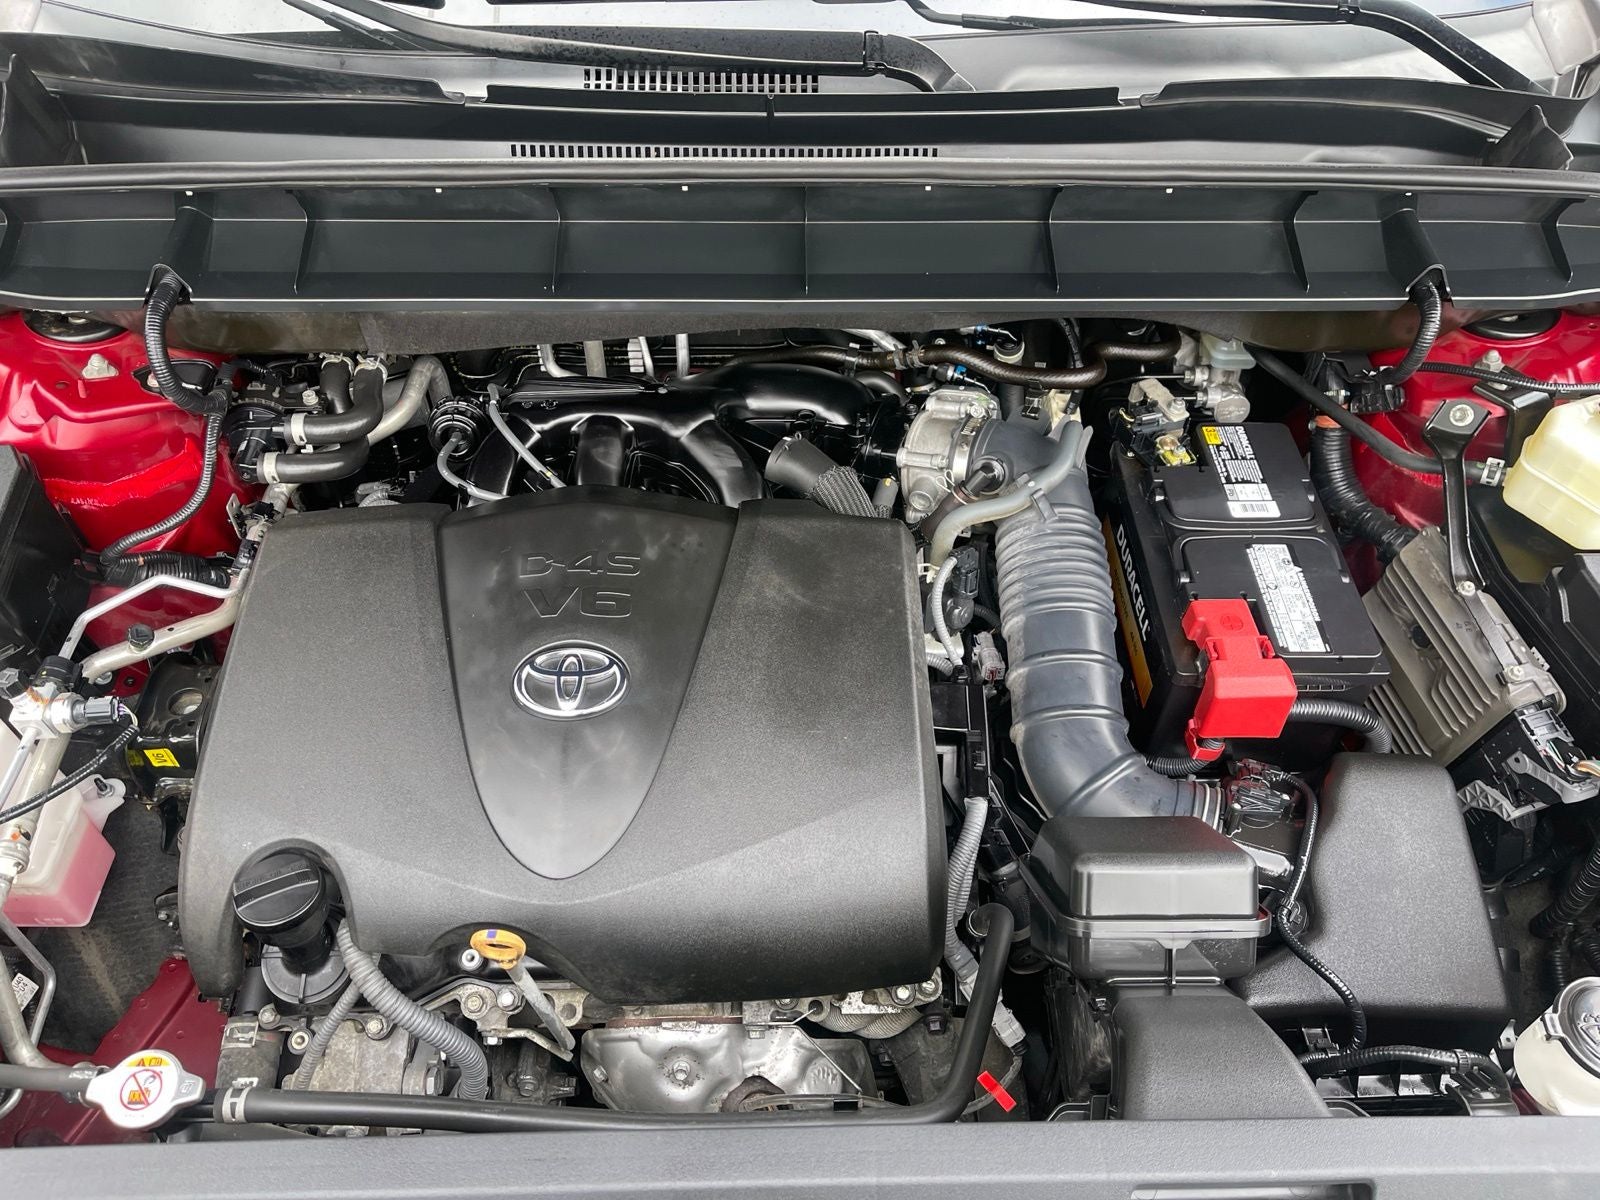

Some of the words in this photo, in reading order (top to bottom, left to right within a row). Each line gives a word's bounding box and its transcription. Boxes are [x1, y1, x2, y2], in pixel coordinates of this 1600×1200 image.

[1235, 426, 1255, 459] DURACELL
[519, 551, 641, 578] D-4S
[1117, 523, 1150, 641] DURACELL
[522, 586, 633, 618] V6
[152, 753, 167, 764] V6
